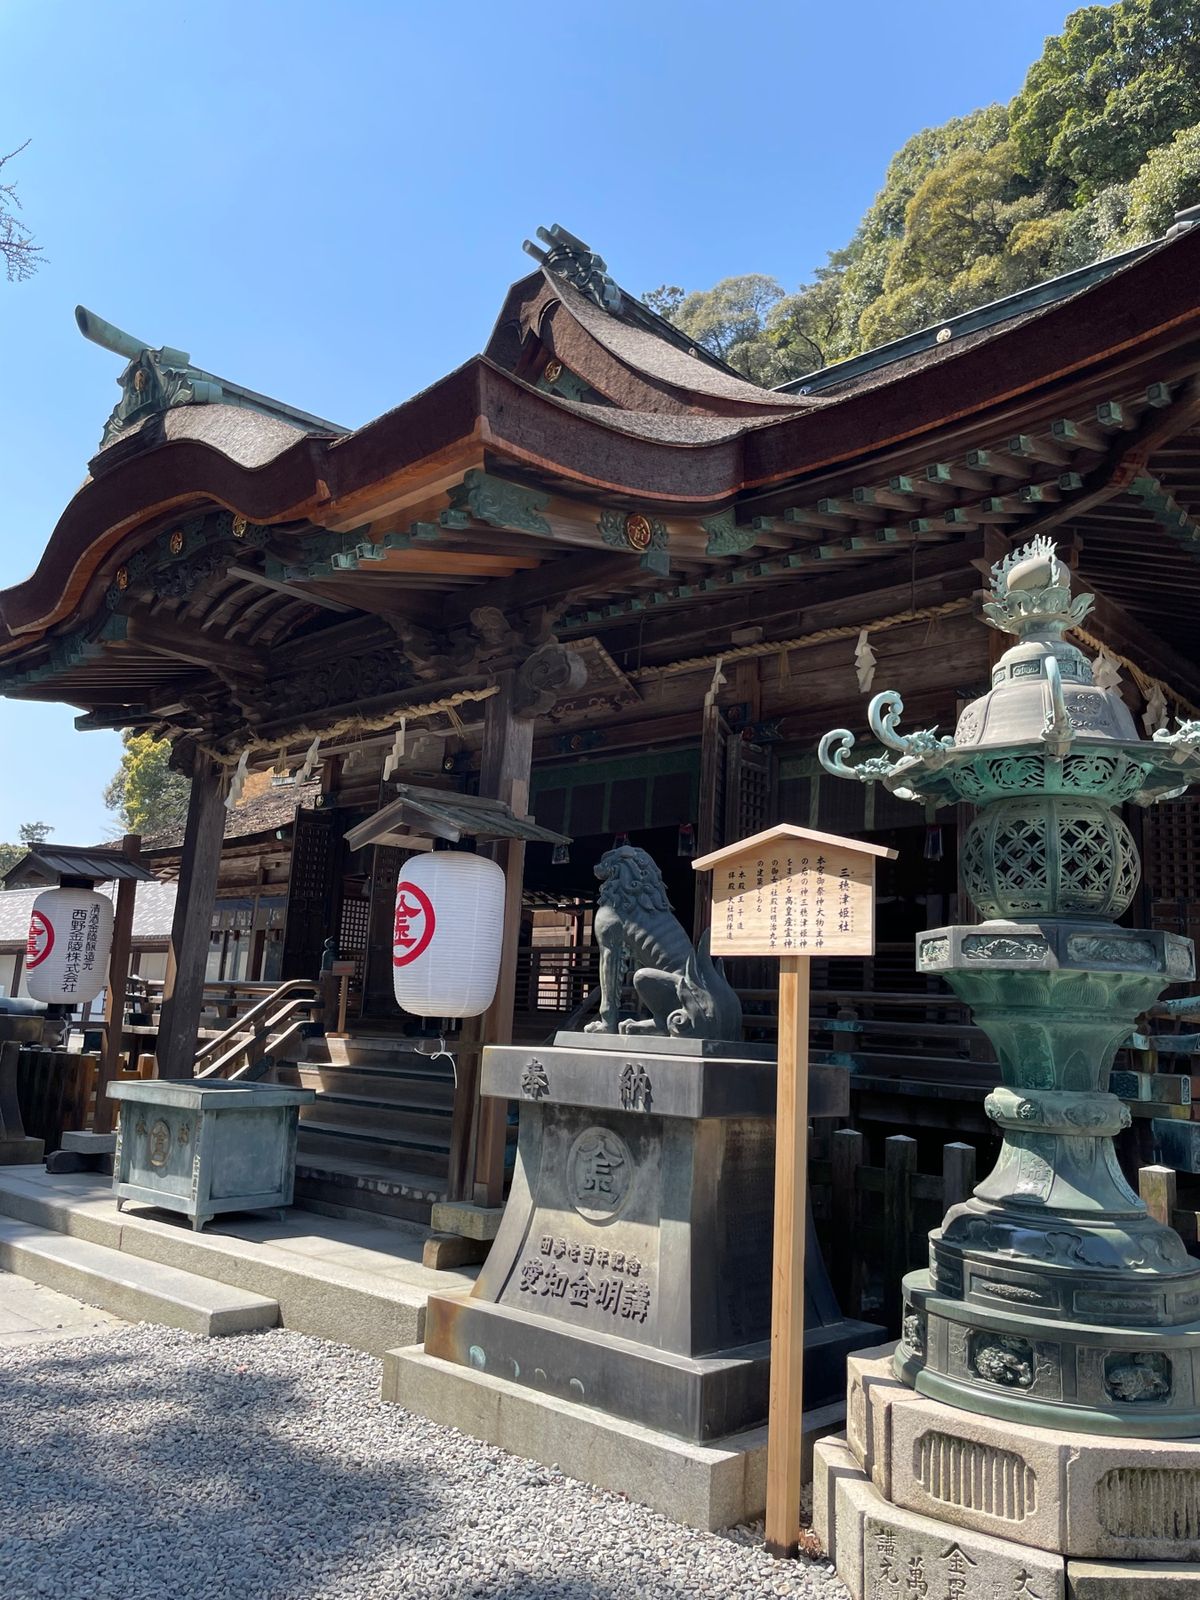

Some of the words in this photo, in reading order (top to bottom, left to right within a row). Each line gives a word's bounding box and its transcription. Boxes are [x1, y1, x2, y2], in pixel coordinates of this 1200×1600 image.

[815, 855, 826, 948] 本宮御祭神大物主神
[838, 867, 851, 933] 三穂津姫社
[61, 908, 88, 993] 西野金陵株式会社
[519, 1256, 651, 1323] 愛知金明講
[906, 1556, 929, 1600] 萬
[1014, 1567, 1043, 1600] 大
